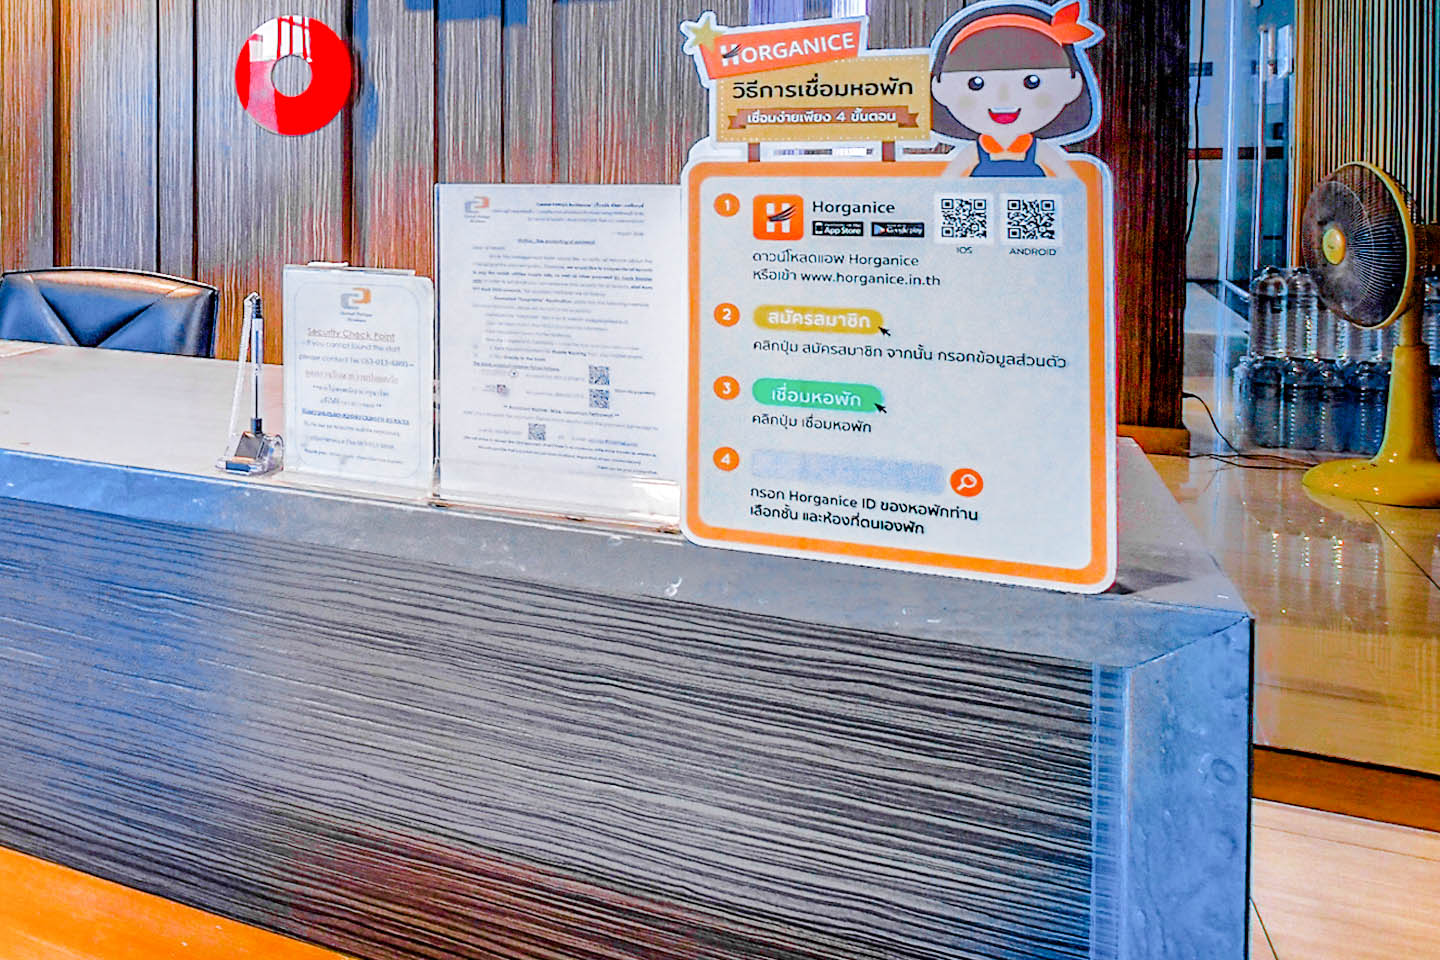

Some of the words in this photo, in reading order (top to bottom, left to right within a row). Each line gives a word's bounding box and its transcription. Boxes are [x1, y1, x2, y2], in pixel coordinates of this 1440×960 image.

[720, 32, 855, 67] HORGANICE
[732, 73, 914, 99] วิธีการเชื่อมหอพัก
[747, 109, 833, 124] เชื่อมง่ายเพียง
[835, 112, 846, 122] 4
[850, 107, 897, 123] ขั้นตอน
[724, 199, 731, 212] 1
[812, 201, 896, 217] Horganice
[824, 226, 841, 235] App
[841, 226, 862, 235] Store
[752, 248, 845, 265] ดาวน์โหลดแอพ
[849, 253, 919, 268] Horganice
[1009, 247, 1057, 256] ANDROID
[753, 267, 797, 281] หรือเข้า
[800, 271, 941, 287] www.horganice.in.th
[722, 308, 732, 321] 2
[767, 309, 871, 329] สมัครสมาชิก
[307, 327, 341, 338] Security
[343, 329, 371, 340] Check
[374, 332, 396, 342] Point
[753, 339, 799, 356] คลิกปุ่ม
[802, 341, 883, 358] สมัครสมาชิก
[886, 343, 933, 361] จากนั้น
[937, 349, 1067, 369] กรอกข้อมูลส่วนตัว
[722, 381, 732, 395] 3
[771, 383, 862, 407] เชื่อมหอพัก
[752, 413, 798, 430] คลิกปุ่ม
[801, 414, 872, 433] เชื่อมหอพัก
[720, 453, 731, 465] 4
[750, 486, 786, 501] กรอก
[789, 490, 858, 509] Horganice
[861, 498, 877, 510] ID
[880, 499, 980, 522] ของหอพักท่าน
[750, 503, 799, 521] เลือกชั้น
[802, 510, 926, 535] และห้องที่ตนเองพัก
